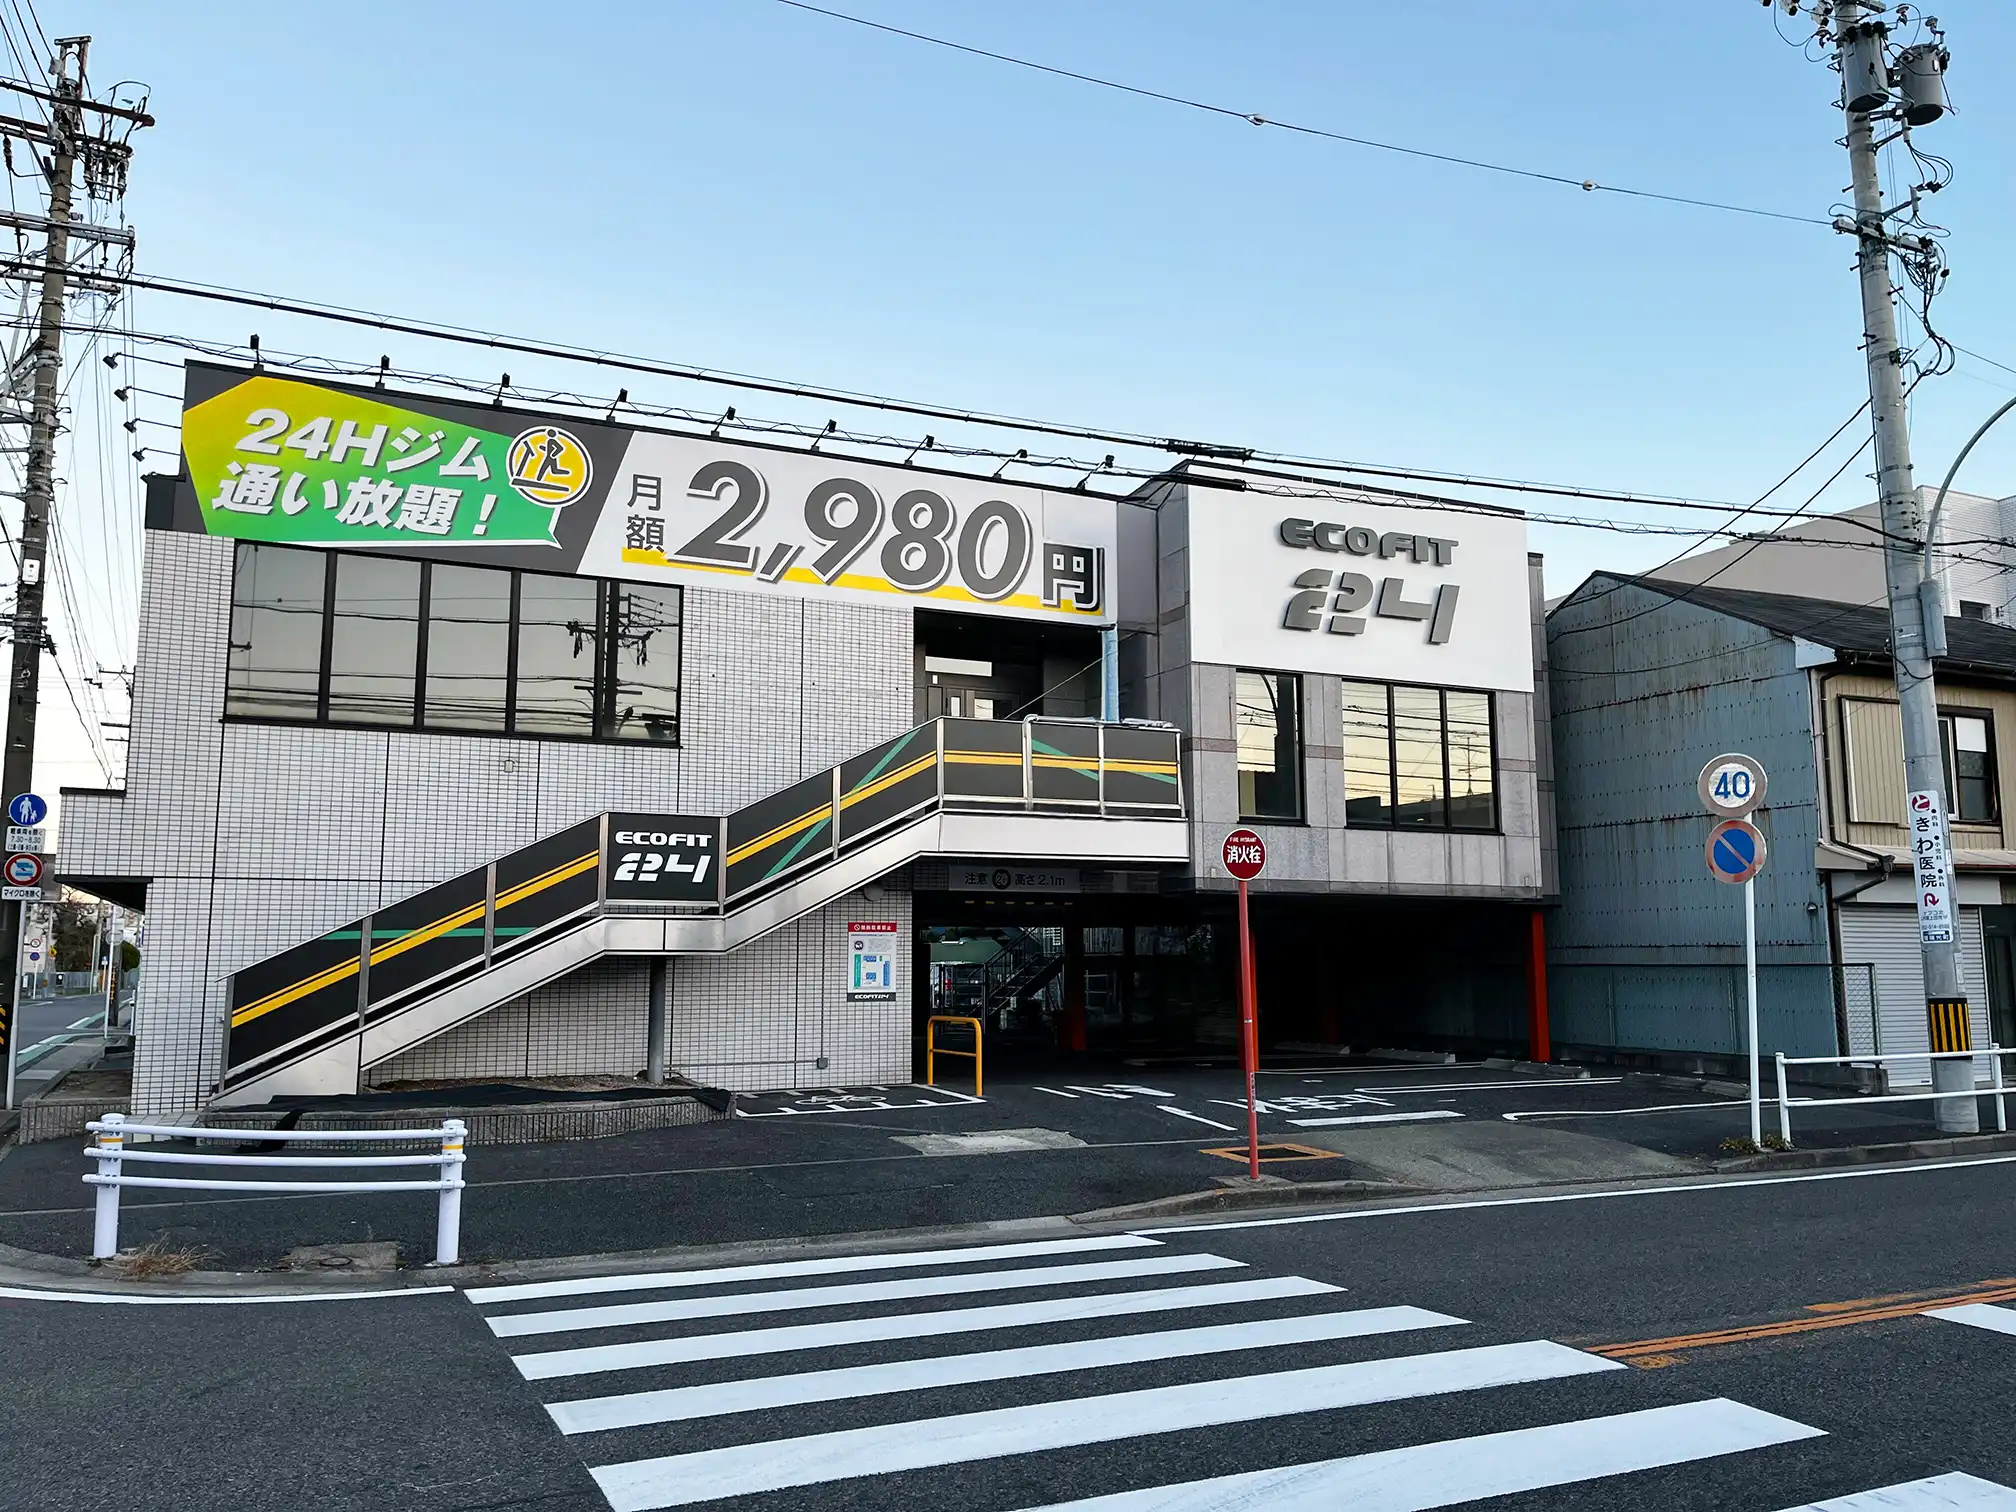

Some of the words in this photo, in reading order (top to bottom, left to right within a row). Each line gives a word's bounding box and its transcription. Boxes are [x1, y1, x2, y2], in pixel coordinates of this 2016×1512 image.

[235, 408, 490, 482] 24Hジム
[626, 473, 666, 553] 月額
[1280, 517, 1459, 566] ECOFIT
[1282, 568, 1461, 645] 24
[1714, 771, 1750, 799] 40
[615, 831, 712, 847] ECOFIT
[1226, 845, 1261, 864] 消火栓
[613, 852, 711, 883] 24
[964, 872, 988, 885] 注意
[1014, 873, 1034, 886] 高さ
[1038, 874, 1065, 886] 2.1m
